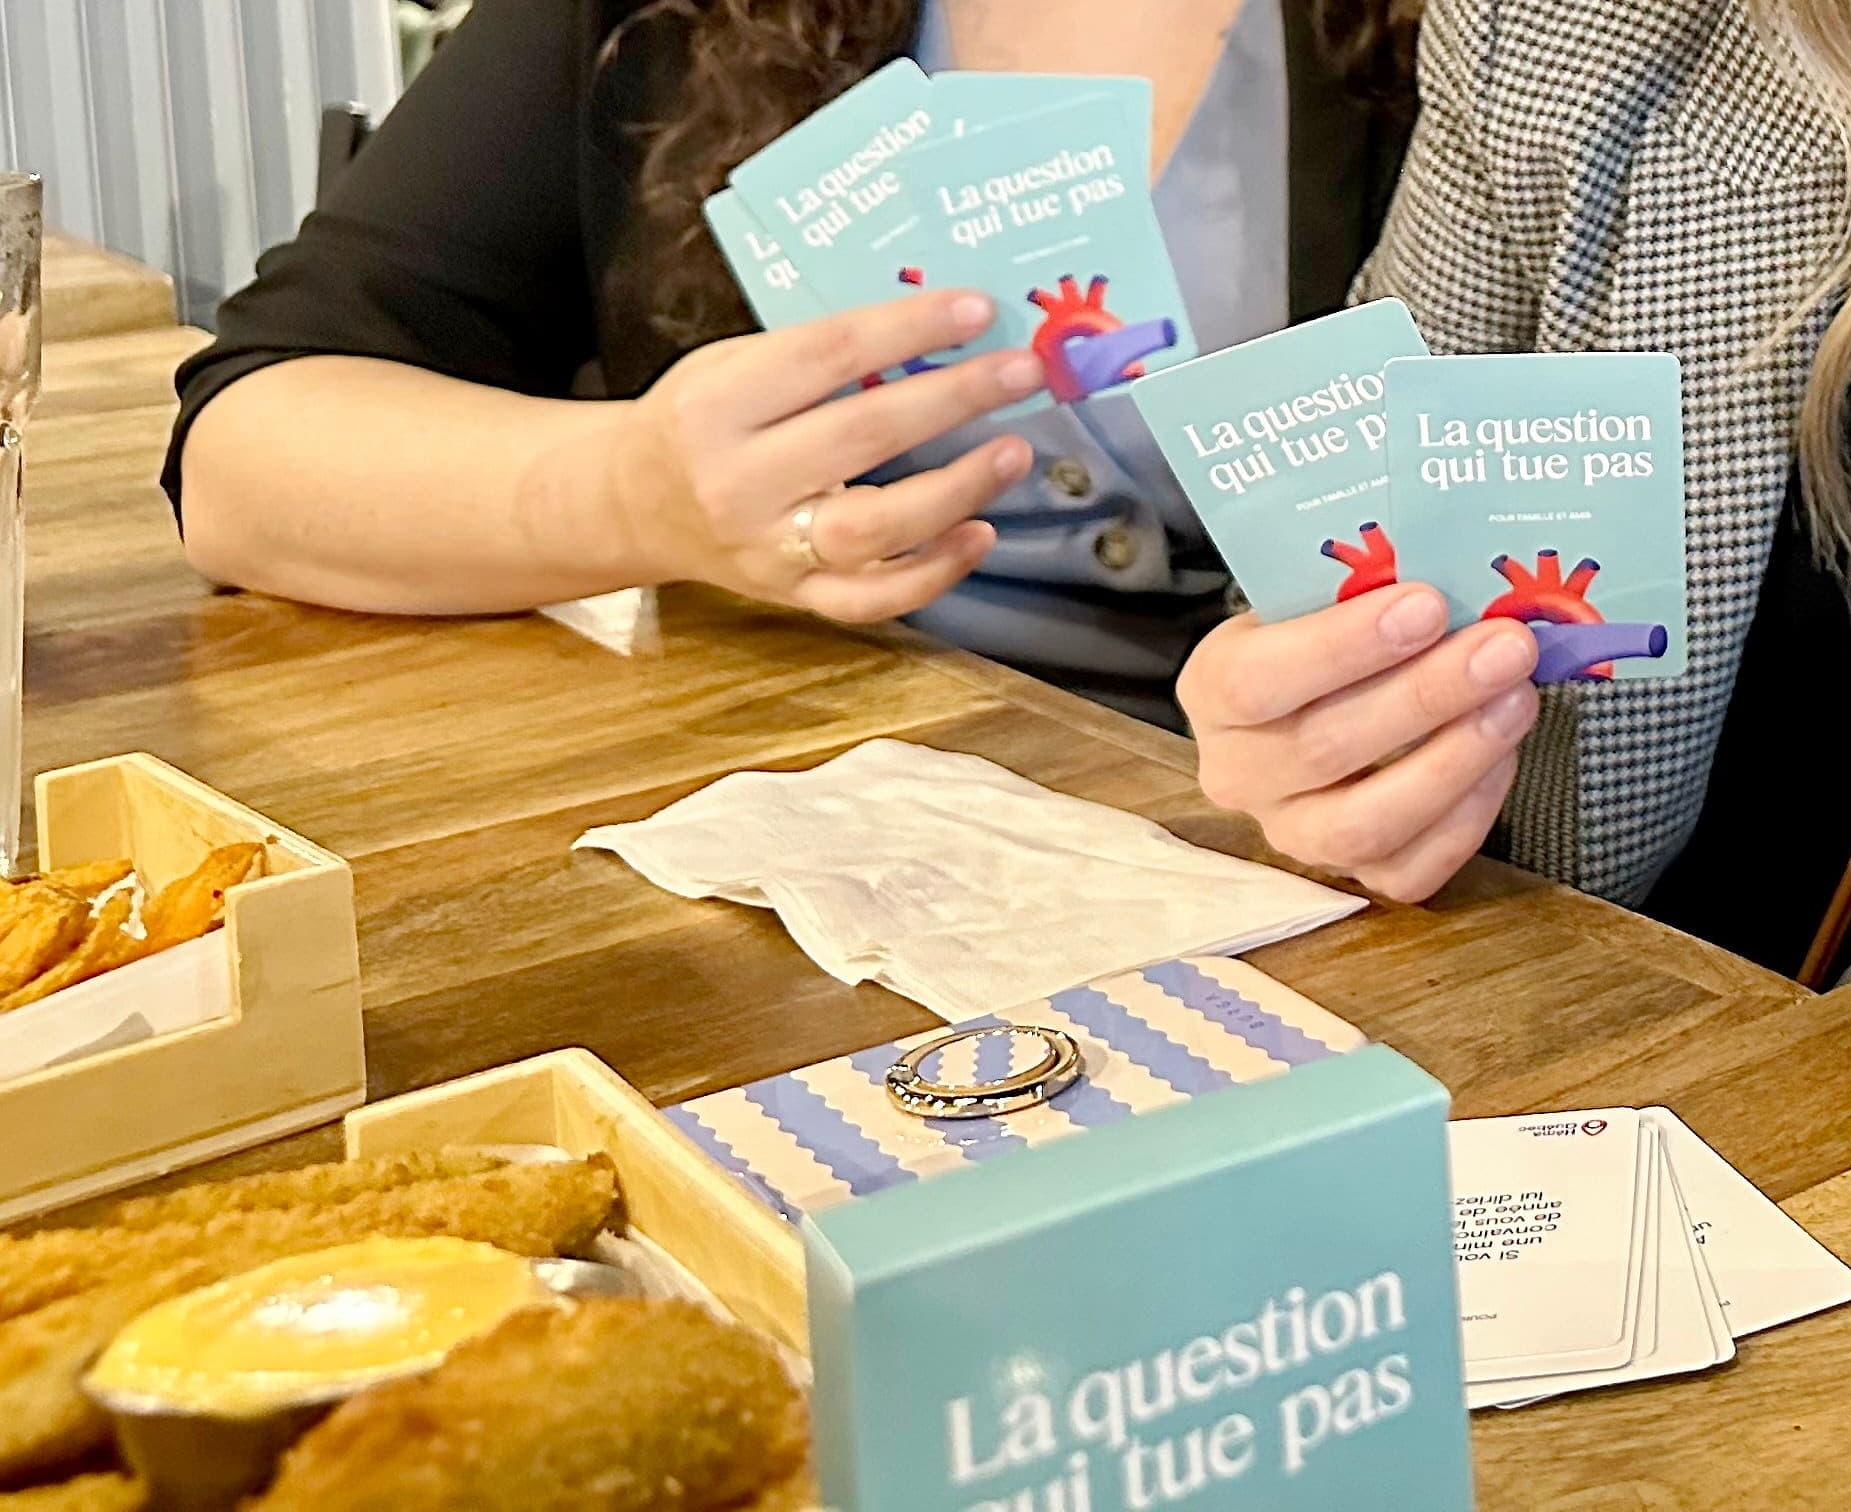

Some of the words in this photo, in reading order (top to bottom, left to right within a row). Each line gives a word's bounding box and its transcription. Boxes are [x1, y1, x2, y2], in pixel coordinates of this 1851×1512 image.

[776, 189, 823, 224] La
[820, 110, 931, 197] question
[938, 185, 982, 215] La
[984, 144, 1115, 204] question
[803, 200, 852, 247] qui
[850, 172, 900, 214] tue
[952, 205, 1003, 248] qui
[1010, 192, 1062, 227] tue
[1068, 173, 1126, 216] pas
[1183, 421, 1244, 457] La
[1243, 373, 1385, 443] questio
[1417, 412, 1470, 448] La
[1476, 408, 1652, 452] question
[1209, 443, 1276, 494] qui
[1280, 426, 1349, 467] tue
[1421, 448, 1487, 490] qui
[1502, 449, 1569, 481] tue
[1584, 450, 1654, 486] pas
[1459, 1207, 1487, 1218] de
[1475, 1216, 1525, 1227] vous
[1495, 1201, 1562, 1214] année
[1520, 1191, 1543, 1202] lui
[1534, 1212, 1561, 1223] de
[1501, 1236, 1542, 1246] une
[944, 1392, 1057, 1484] La
[1067, 1270, 1407, 1450] question
[1121, 1411, 1257, 1510] tue
[1279, 1353, 1413, 1473] pas
